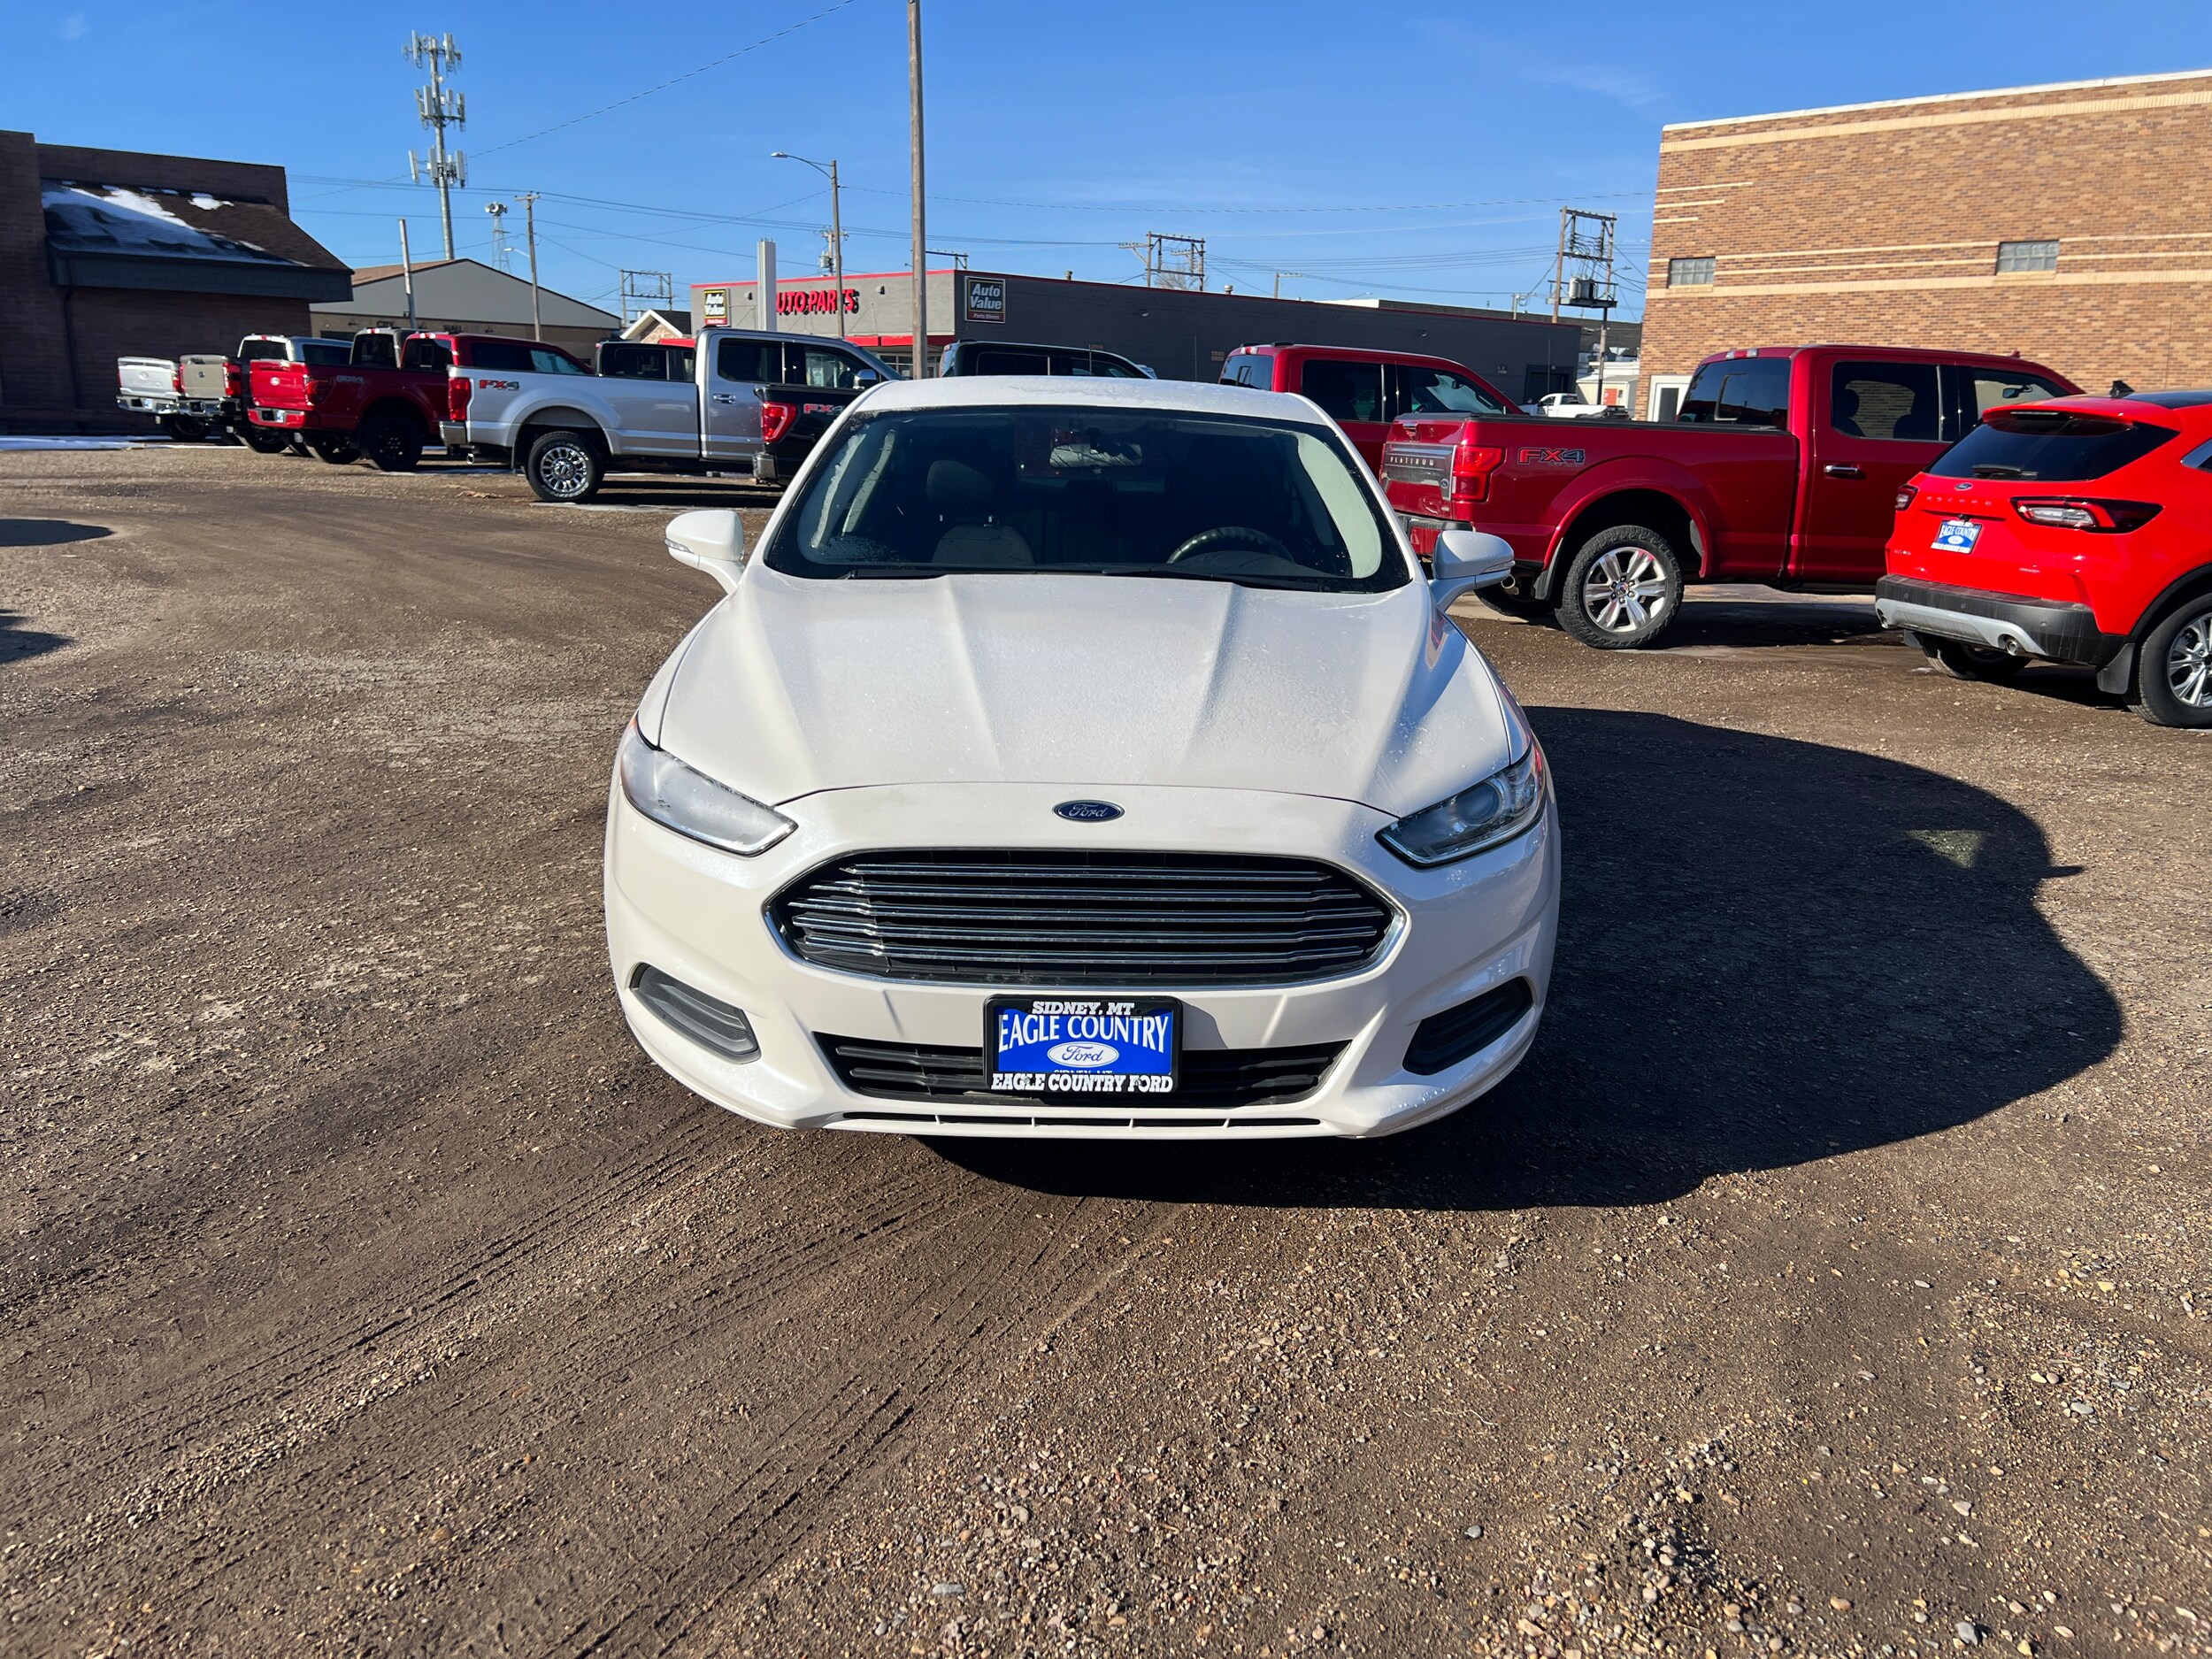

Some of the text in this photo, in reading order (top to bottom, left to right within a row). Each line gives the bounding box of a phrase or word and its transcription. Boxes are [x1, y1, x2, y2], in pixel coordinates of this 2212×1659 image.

[972, 283, 1001, 297] Auto
[776, 290, 807, 313] UTO
[971, 296, 1002, 310] Value
[480, 380, 520, 389] FX4
[1517, 447, 1586, 465] FX4
[1068, 803, 1109, 818] Ford
[1107, 1002, 1135, 1016] MT
[998, 1014, 1169, 1054] EAGLE COUNTRY
[1061, 1045, 1104, 1062] Ford
[991, 1073, 1173, 1093] EAGLE COUNTRY FORD
